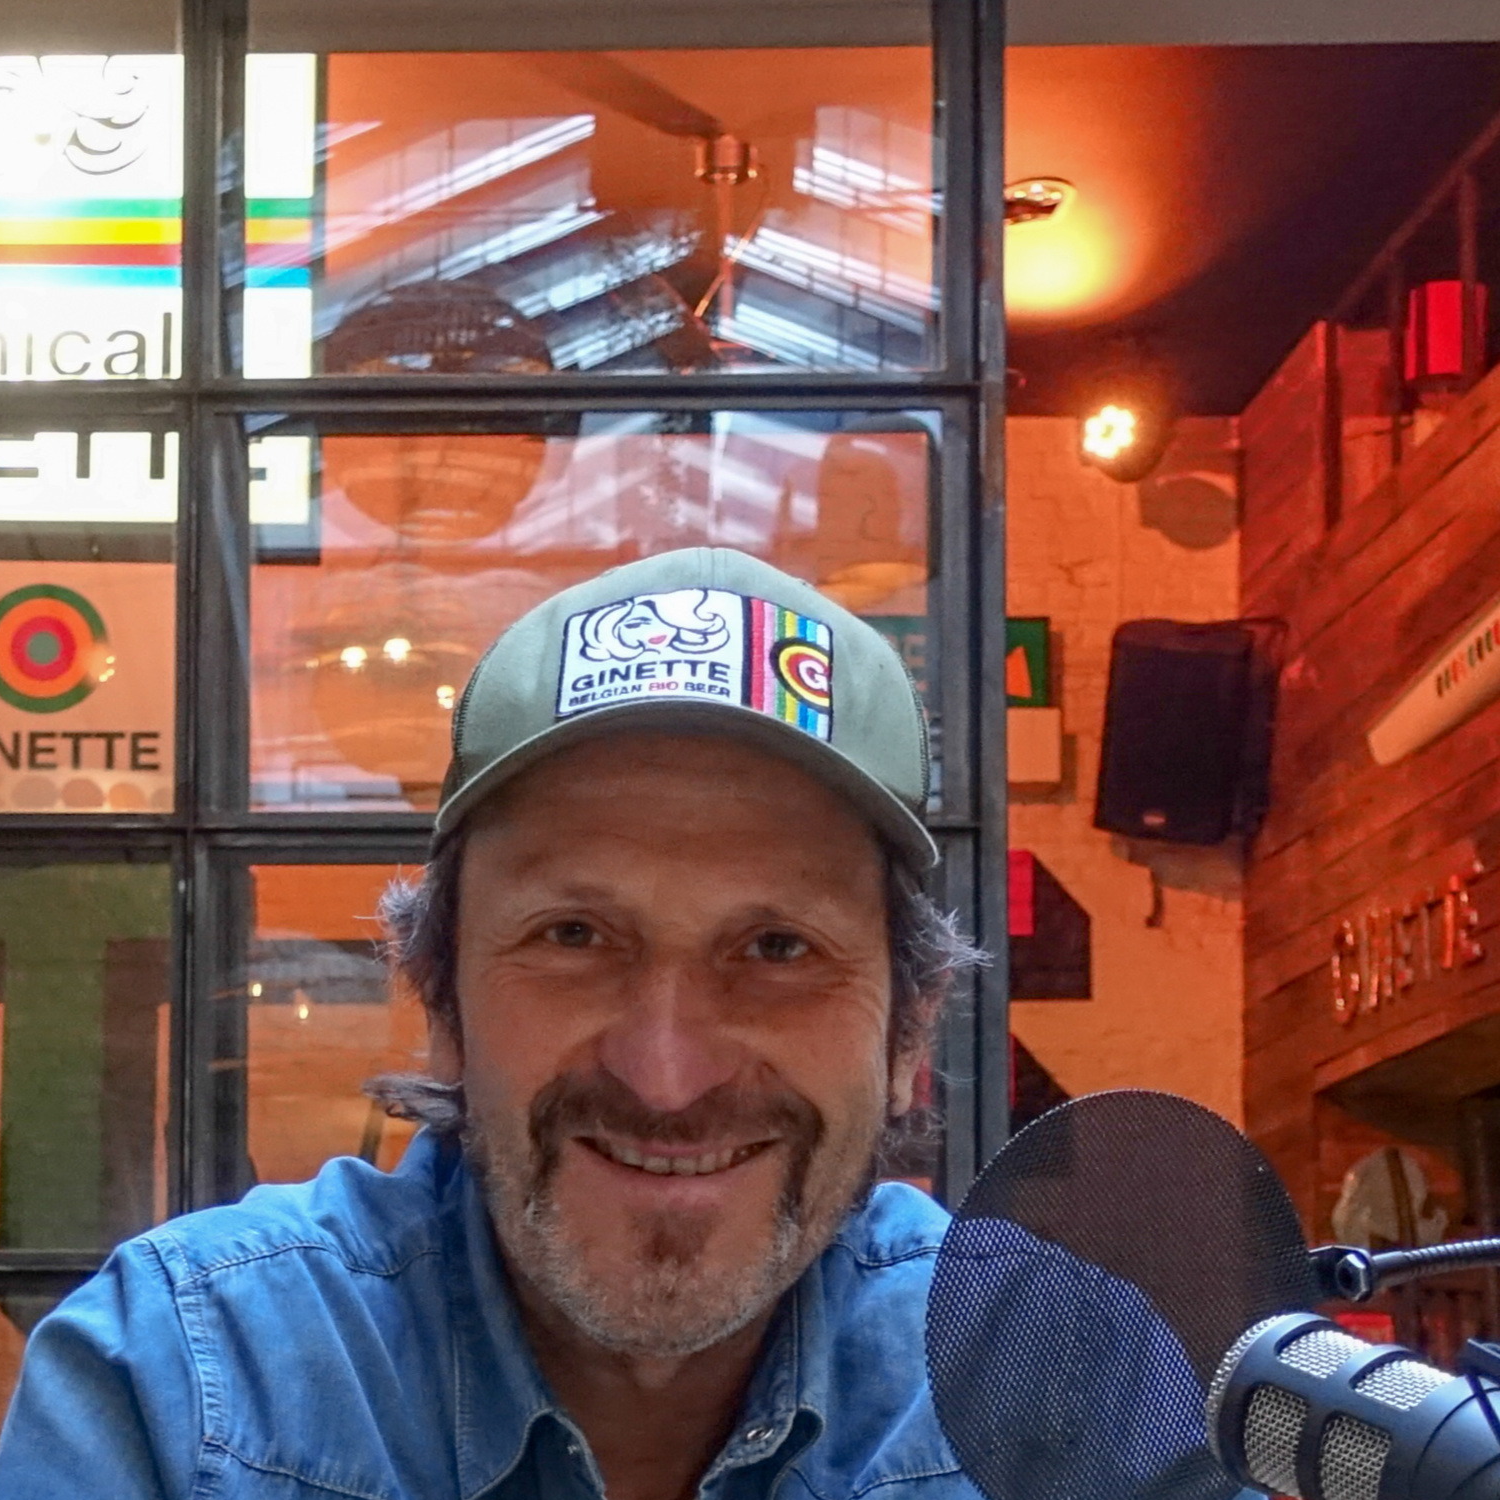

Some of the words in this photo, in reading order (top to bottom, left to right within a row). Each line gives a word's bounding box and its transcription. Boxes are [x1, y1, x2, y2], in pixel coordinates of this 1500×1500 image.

[571, 660, 731, 692] GINETTE
[798, 659, 828, 692] G
[568, 684, 642, 707] BELGIAN
[648, 681, 679, 691] BIO
[684, 682, 731, 698] BEER
